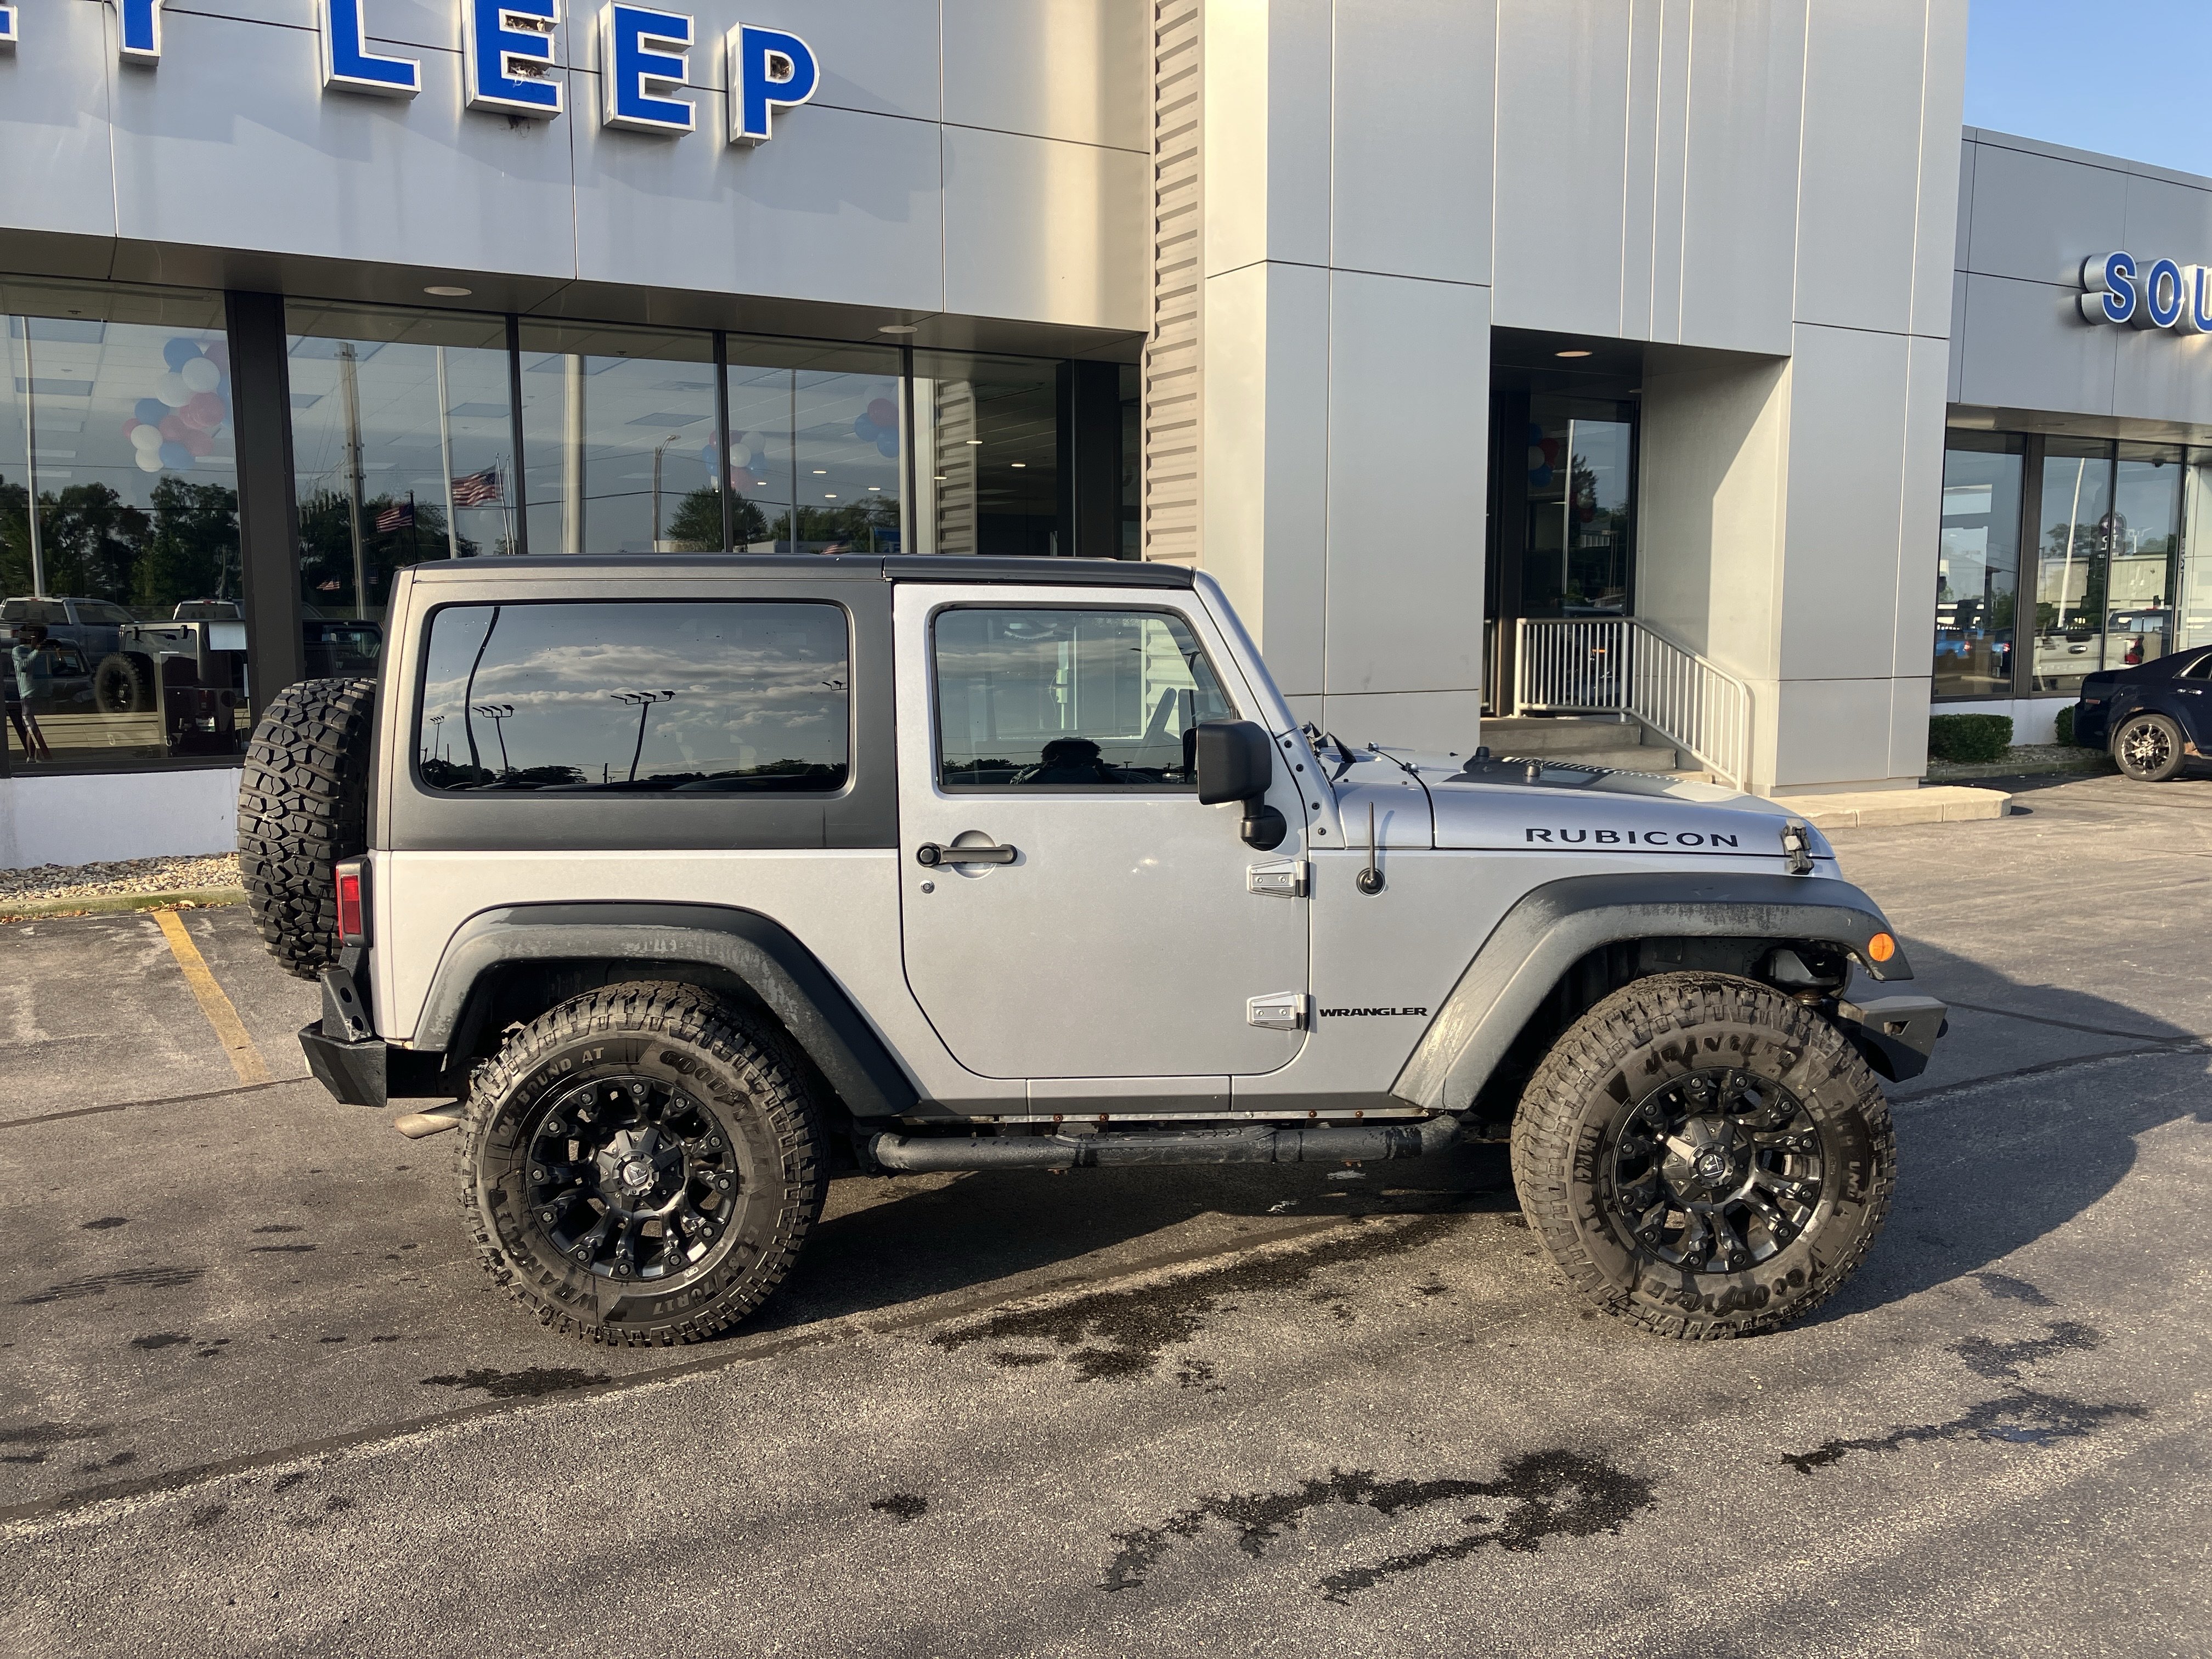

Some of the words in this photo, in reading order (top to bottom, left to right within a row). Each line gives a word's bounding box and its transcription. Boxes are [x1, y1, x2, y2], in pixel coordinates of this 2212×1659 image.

[1525, 827, 1739, 848] RUBICON
[1319, 1007, 1428, 1017] WRANGLER
[498, 1057, 572, 1137] OUTBOUND
[582, 1046, 605, 1063] AT
